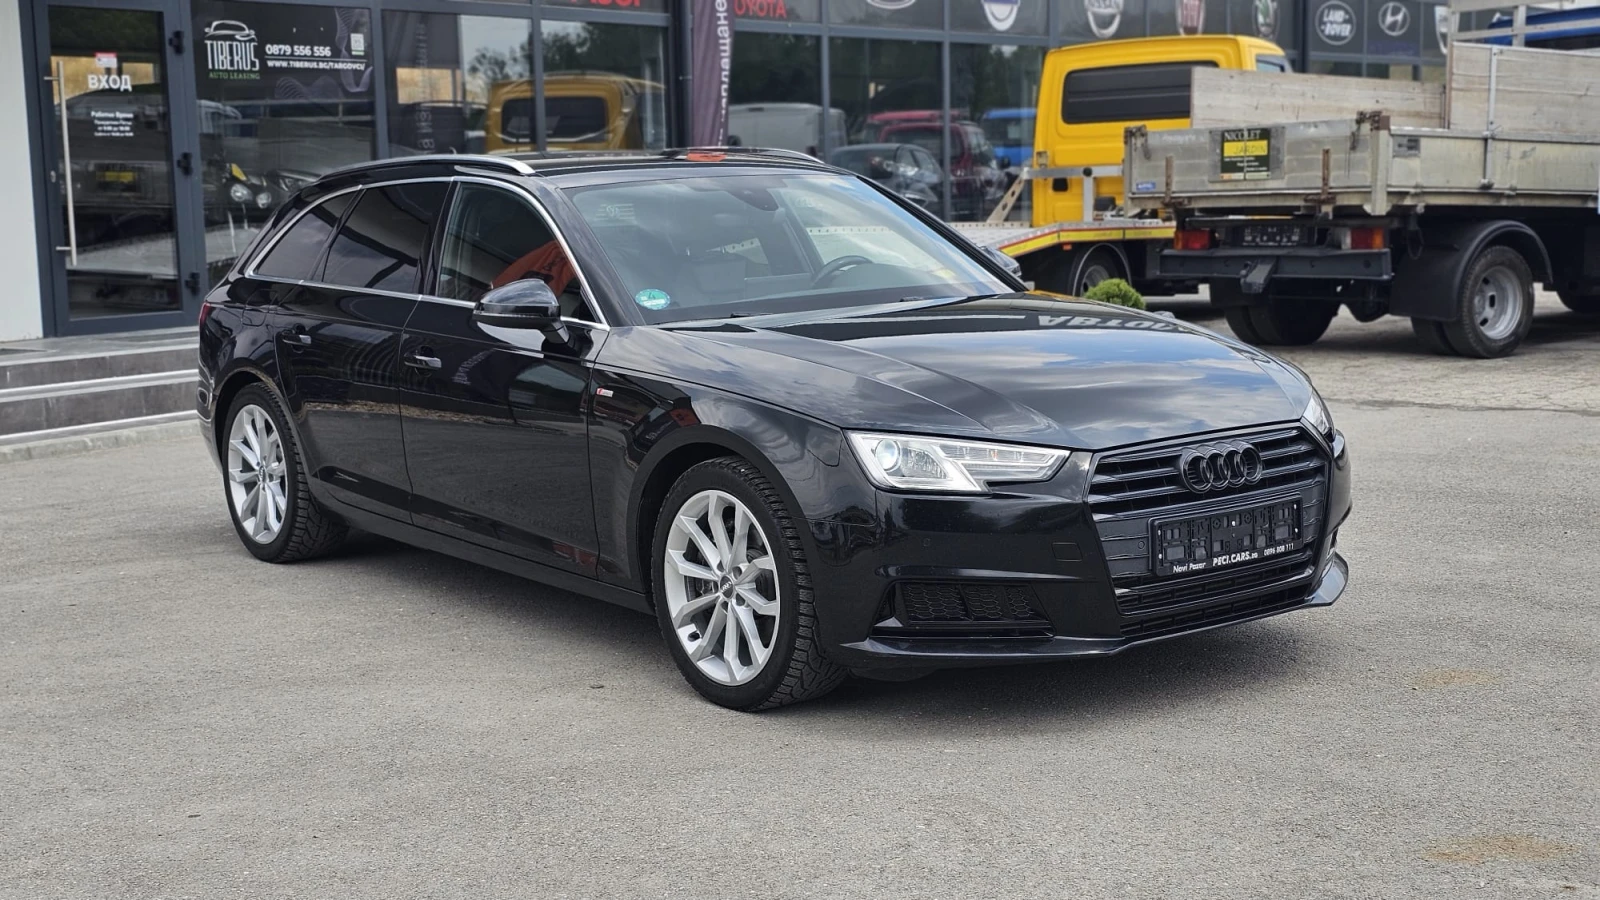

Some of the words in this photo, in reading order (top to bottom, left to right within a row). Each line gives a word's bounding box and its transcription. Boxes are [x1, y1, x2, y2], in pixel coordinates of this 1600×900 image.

[734, 0, 787, 18] OYOTA
[204, 40, 260, 71] TIBERUS
[265, 44, 292, 55] 0879
[293, 45, 312, 56] 556
[313, 46, 332, 57] 556
[87, 74, 133, 92] ВХОД
[1172, 563, 1188, 574] Novi
